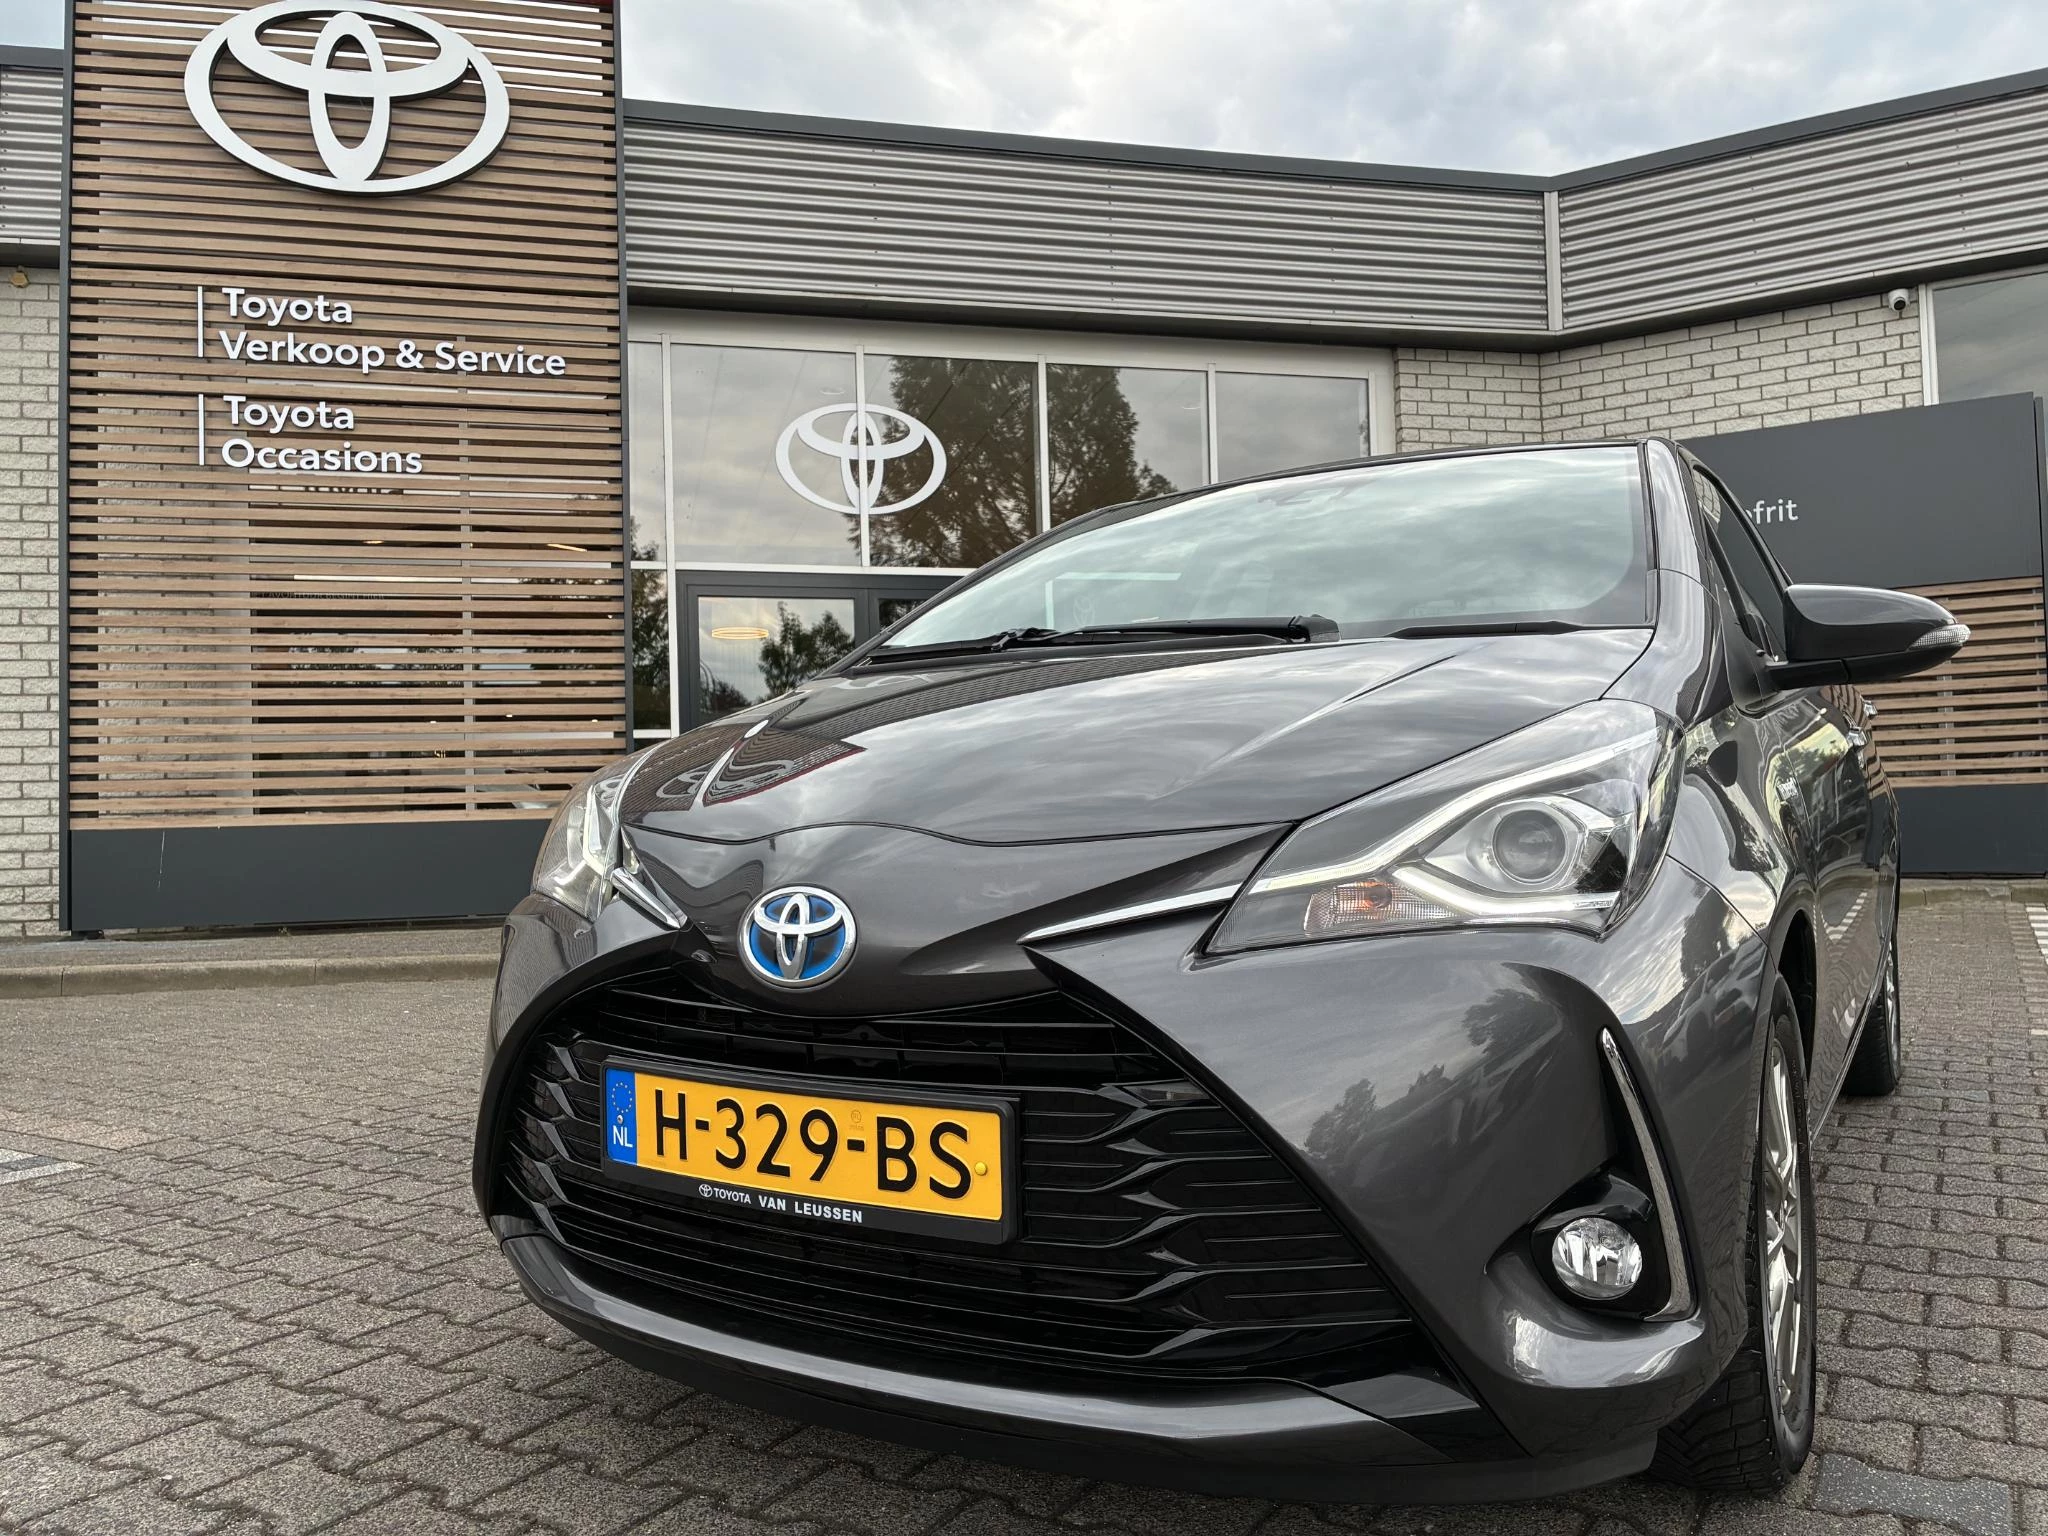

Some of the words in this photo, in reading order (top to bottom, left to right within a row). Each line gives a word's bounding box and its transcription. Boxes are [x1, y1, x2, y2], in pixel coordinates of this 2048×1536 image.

[222, 287, 353, 327] Toyota
[219, 330, 386, 374] Verkoop
[396, 339, 424, 369] &
[435, 341, 566, 376] Service
[223, 395, 355, 434] Toyota
[221, 438, 423, 474] Occasions
[1745, 498, 1799, 525] frit
[612, 1125, 633, 1149] NL
[655, 1088, 972, 1200] H-329-BS
[713, 1187, 752, 1205] TOYOTA
[758, 1195, 786, 1211] VAN
[794, 1201, 863, 1224] LEUSSEN
